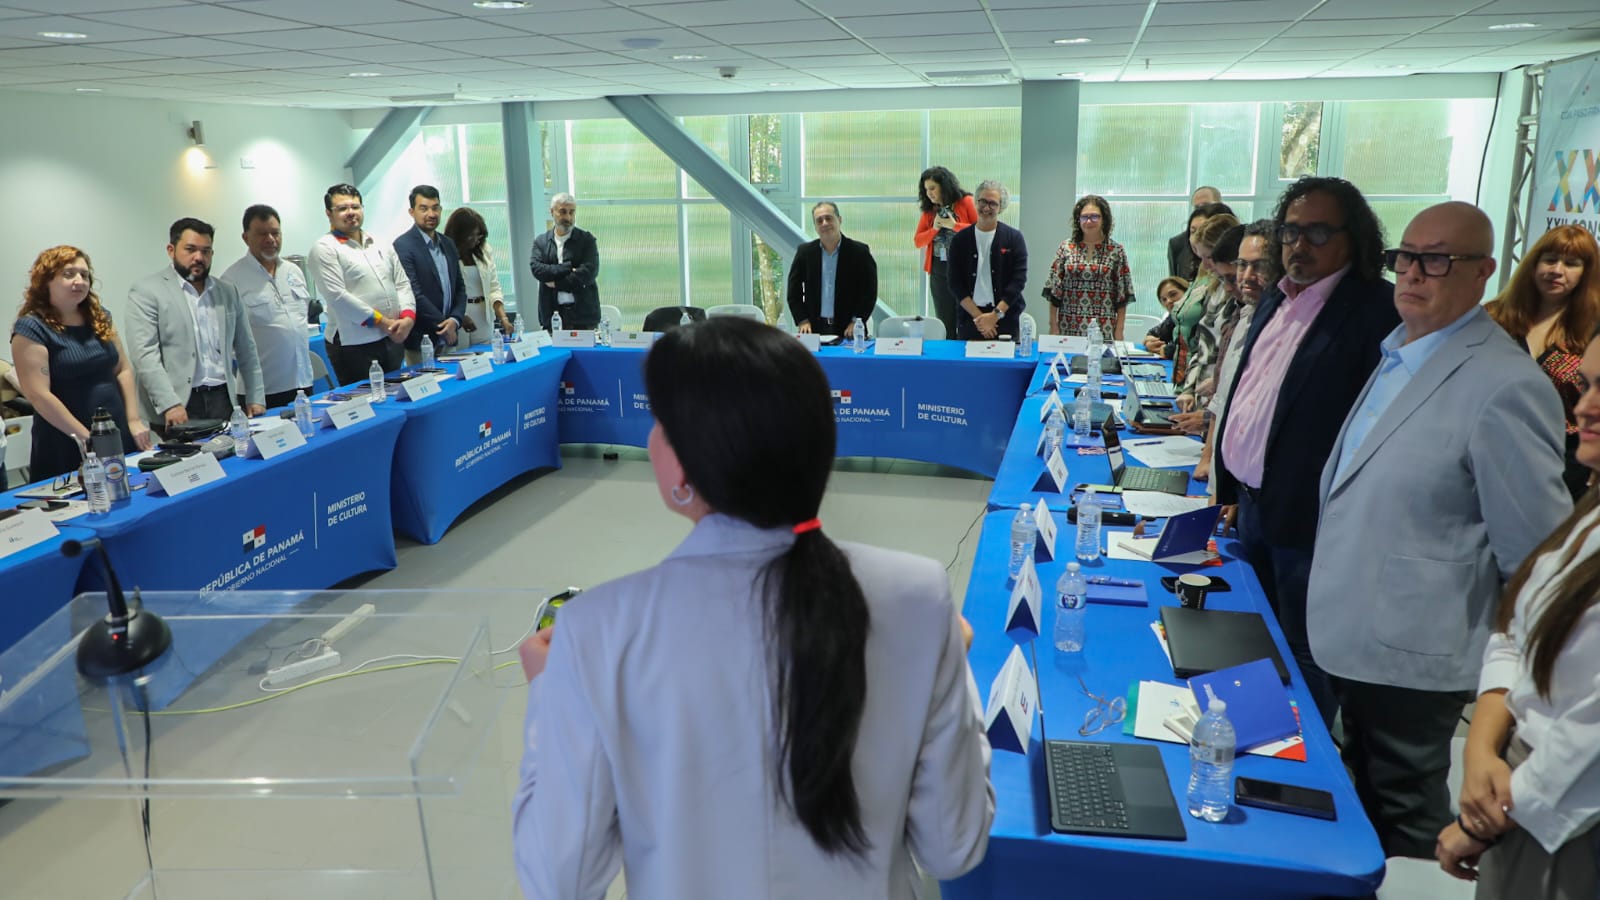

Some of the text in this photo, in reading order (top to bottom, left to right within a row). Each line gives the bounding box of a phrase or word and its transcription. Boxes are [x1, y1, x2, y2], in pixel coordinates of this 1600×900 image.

[576, 398, 610, 406] PANAMÁ
[917, 403, 966, 416] MINISTERIO
[852, 407, 891, 417] PANAMÁ
[917, 412, 968, 426] DE CULTURA
[523, 421, 530, 430] DE
[483, 440, 491, 450] DE
[491, 427, 512, 446] PANAMÁ
[327, 491, 365, 515] MINISTERIO
[327, 503, 367, 527] DE CULTURA
[199, 528, 304, 599] REPÚBLICA DE PANAMÁ
[255, 553, 288, 577] NACIONAL
